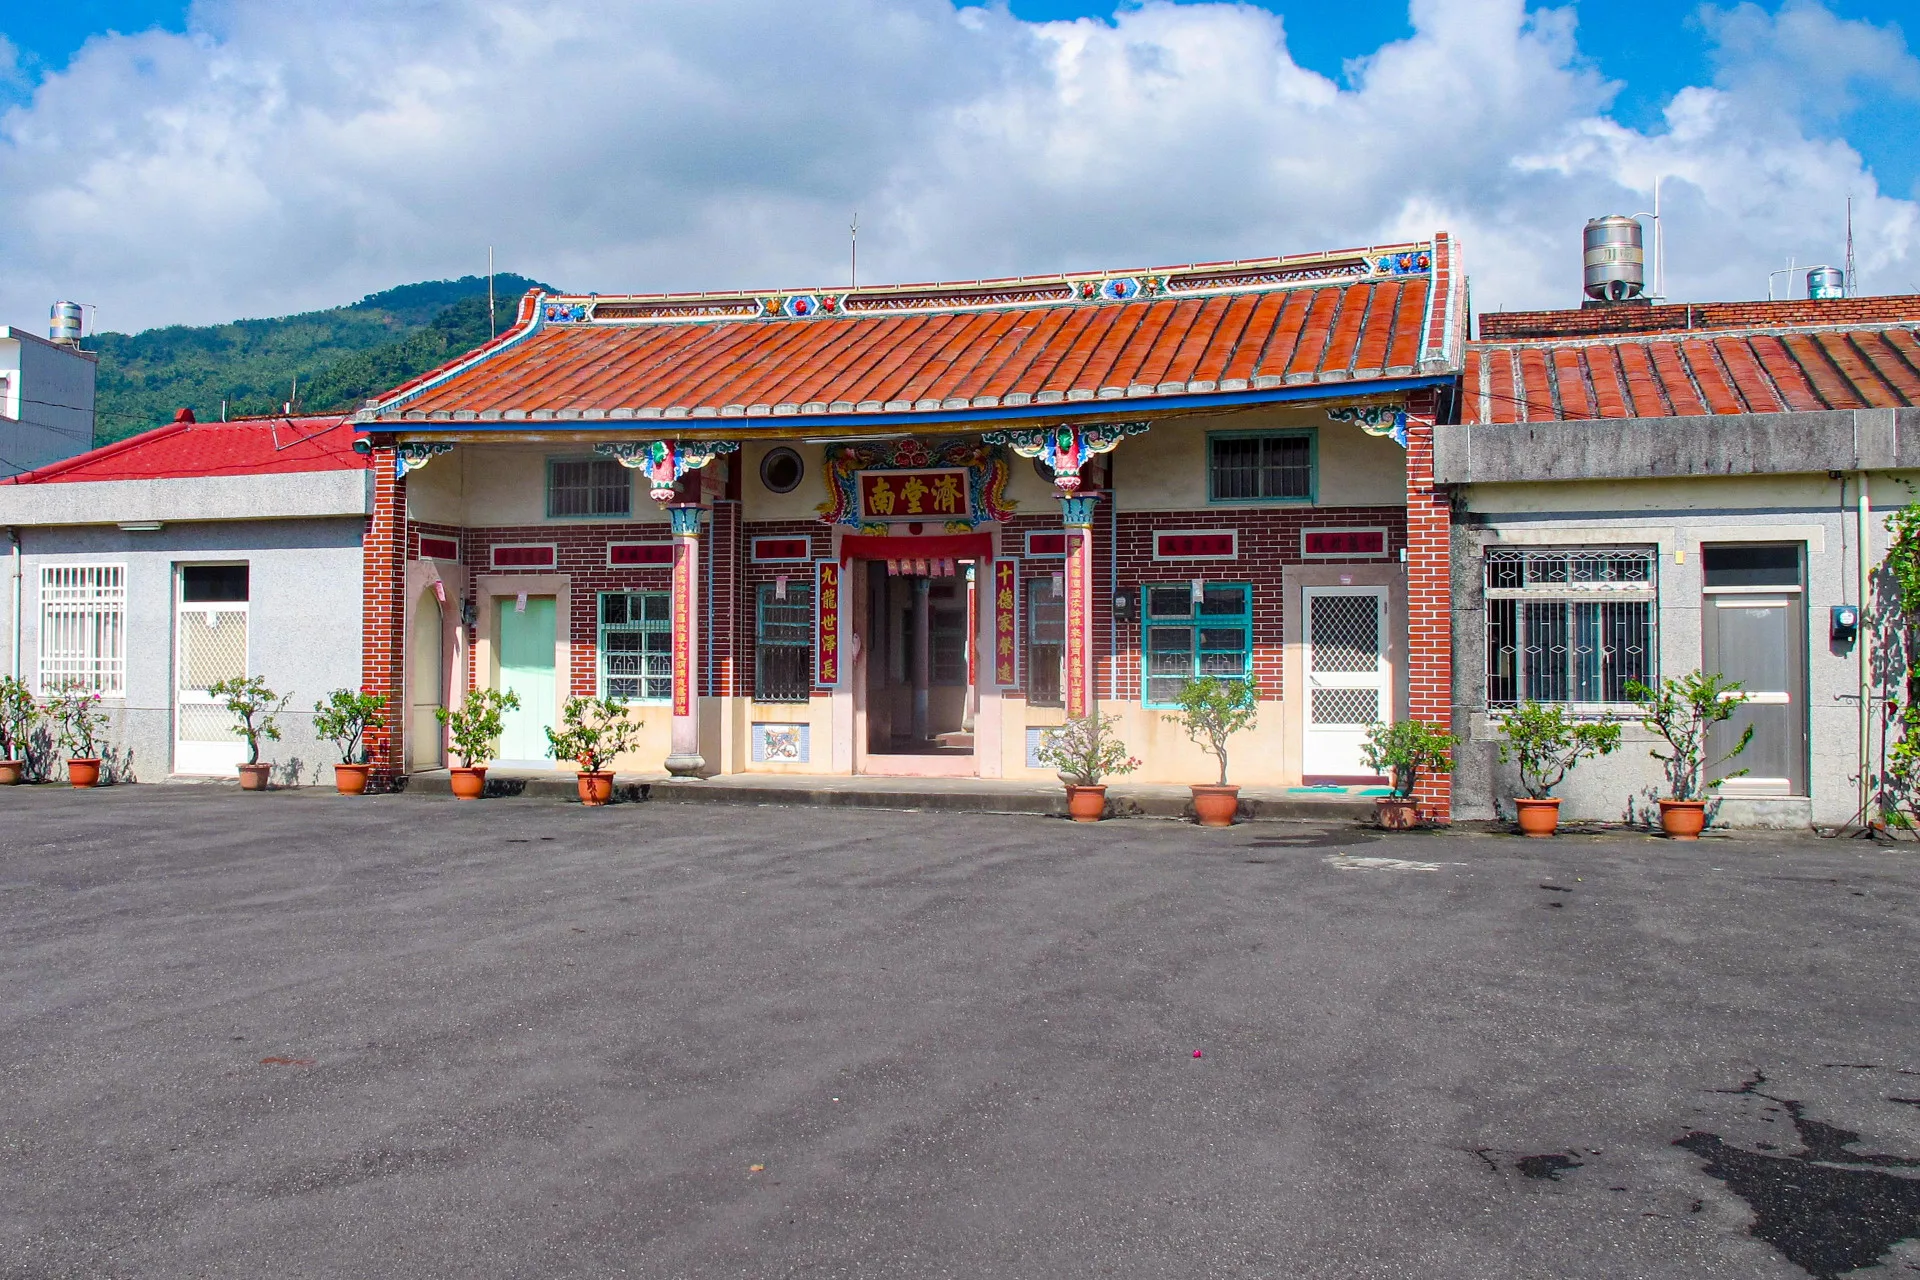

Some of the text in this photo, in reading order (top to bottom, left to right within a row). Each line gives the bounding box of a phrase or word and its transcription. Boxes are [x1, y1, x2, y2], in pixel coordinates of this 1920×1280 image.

[821, 566, 838, 681] 九龍世澤長
[997, 563, 1014, 682] 十德家聲遠
